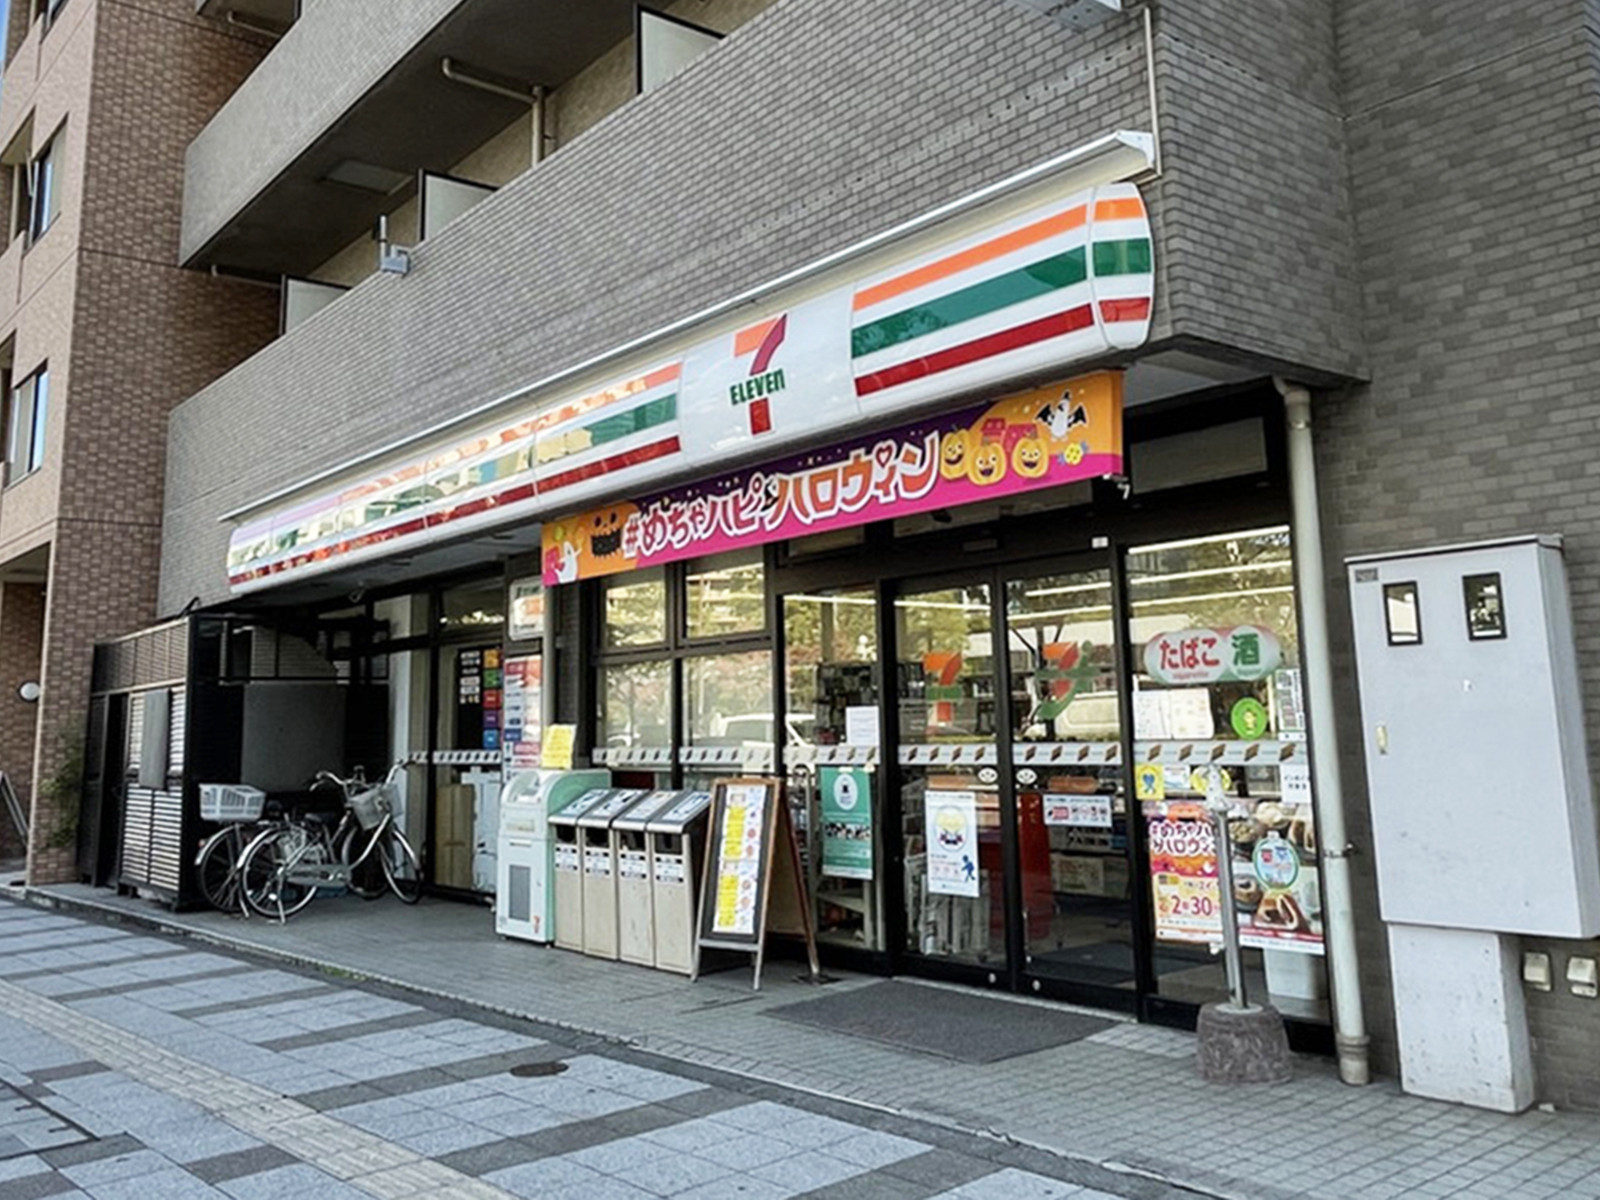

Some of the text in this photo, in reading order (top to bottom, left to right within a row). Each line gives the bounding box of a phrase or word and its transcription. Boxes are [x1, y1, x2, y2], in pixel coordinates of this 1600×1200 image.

[734, 313, 787, 435] 7
[1159, 633, 1260, 670] たばこ 酒
